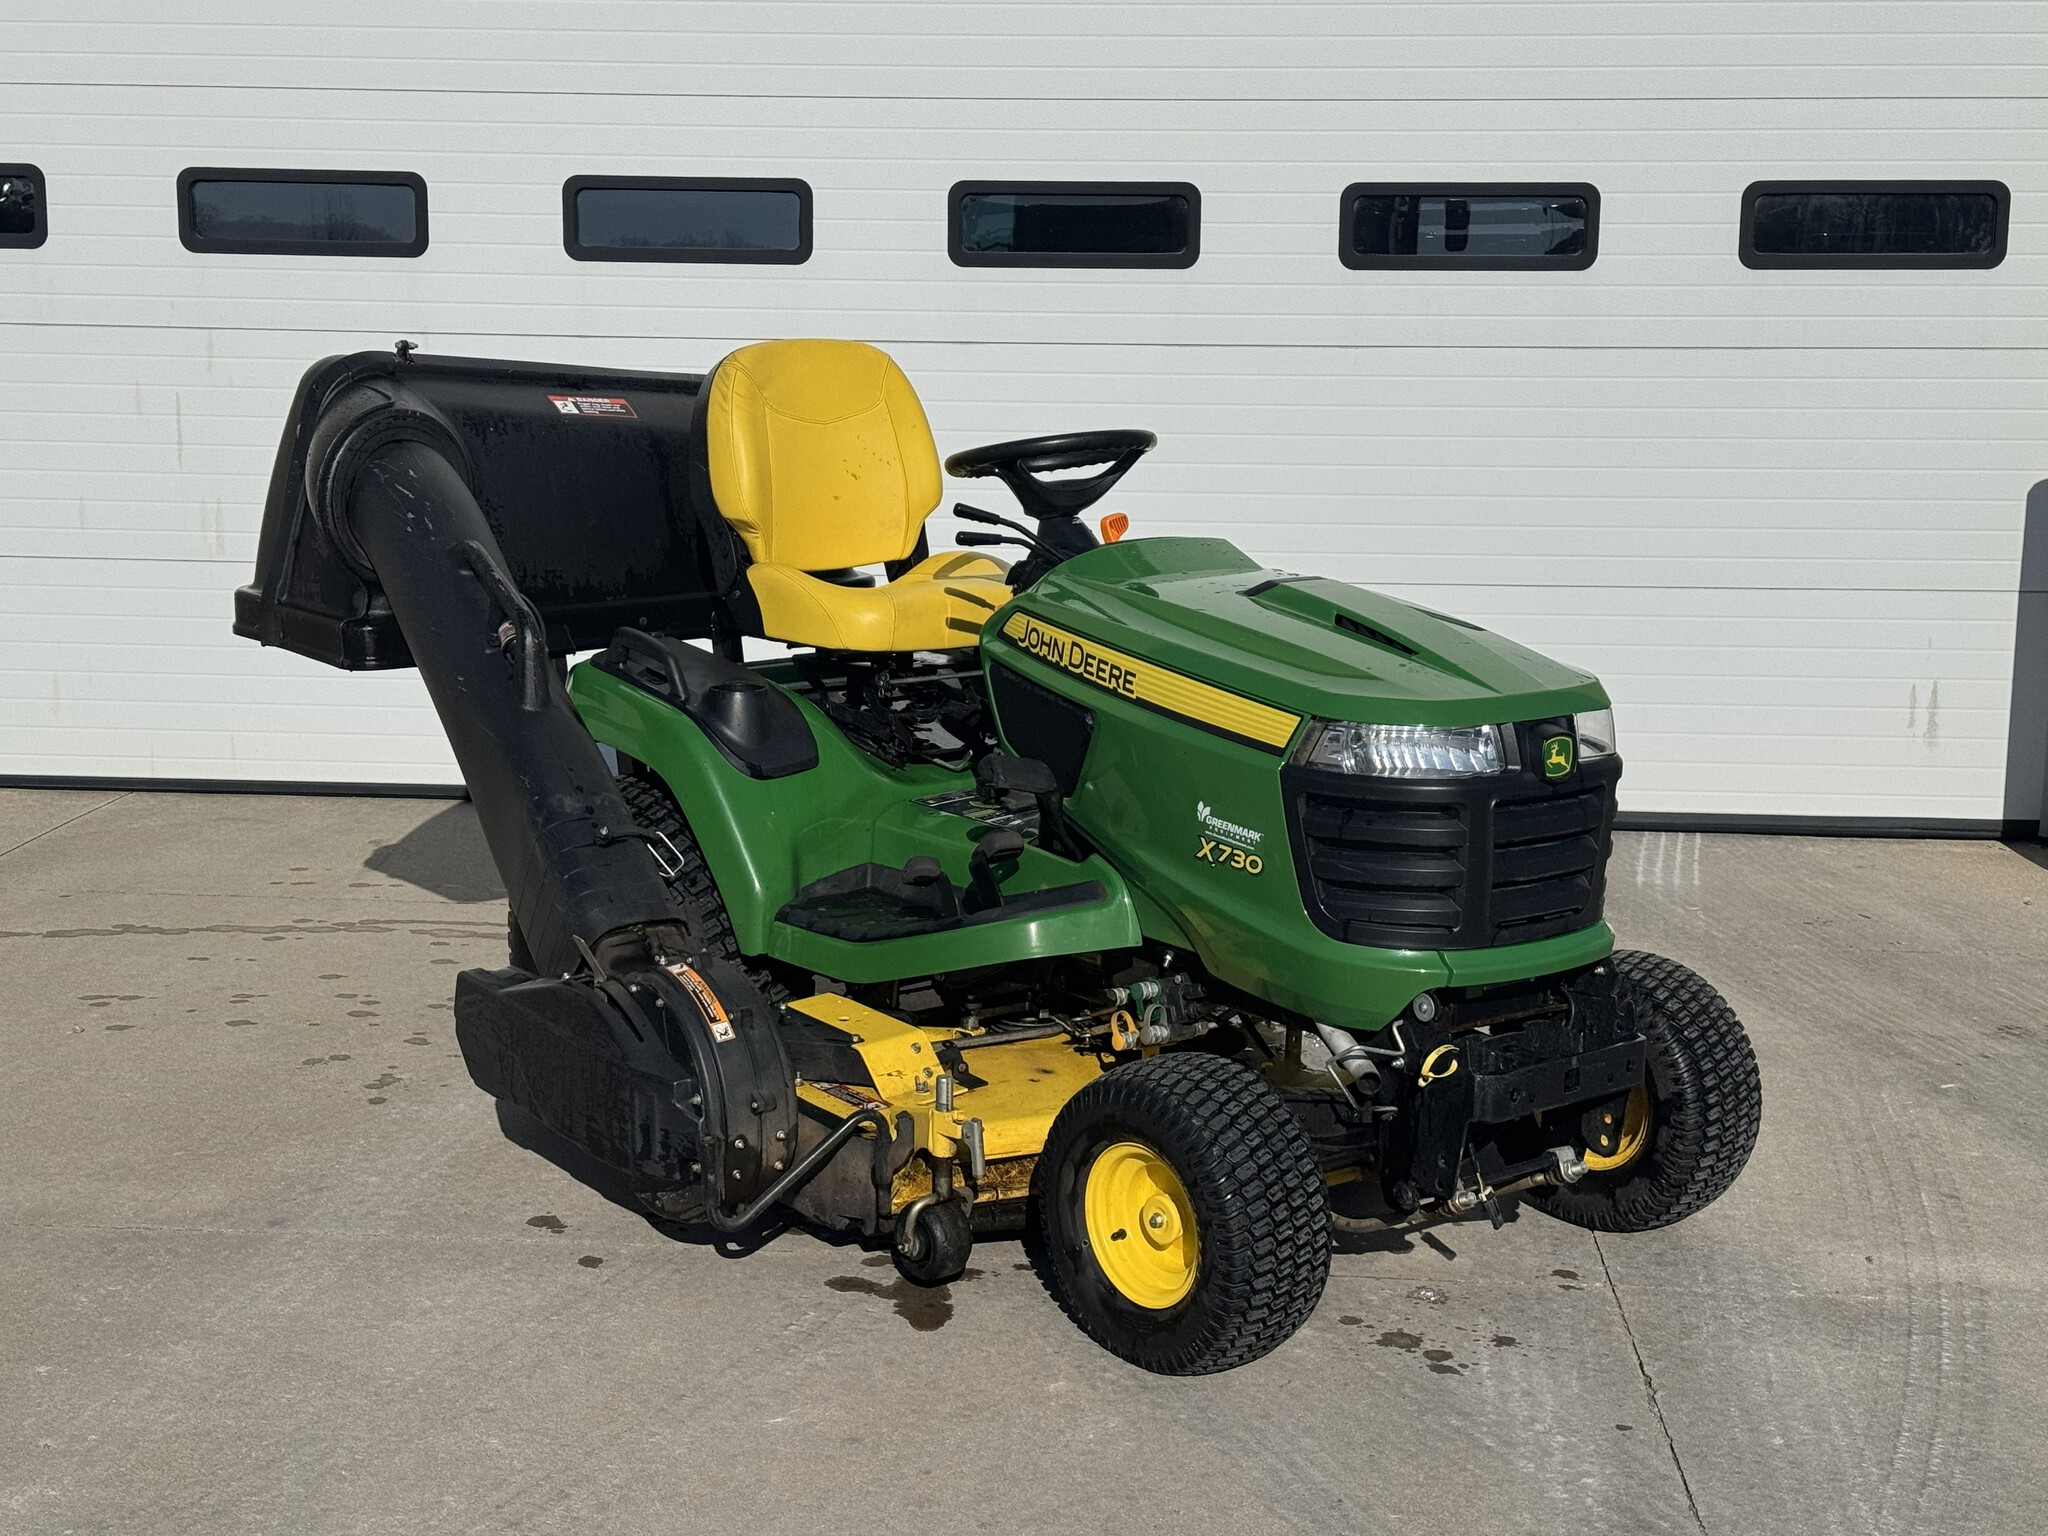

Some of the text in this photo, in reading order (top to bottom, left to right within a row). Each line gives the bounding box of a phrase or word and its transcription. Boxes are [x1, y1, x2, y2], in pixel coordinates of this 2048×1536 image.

[1018, 619, 1137, 696] JOHN DEERE
[1205, 815, 1261, 842] GREENMARK
[1195, 836, 1263, 874] X730
